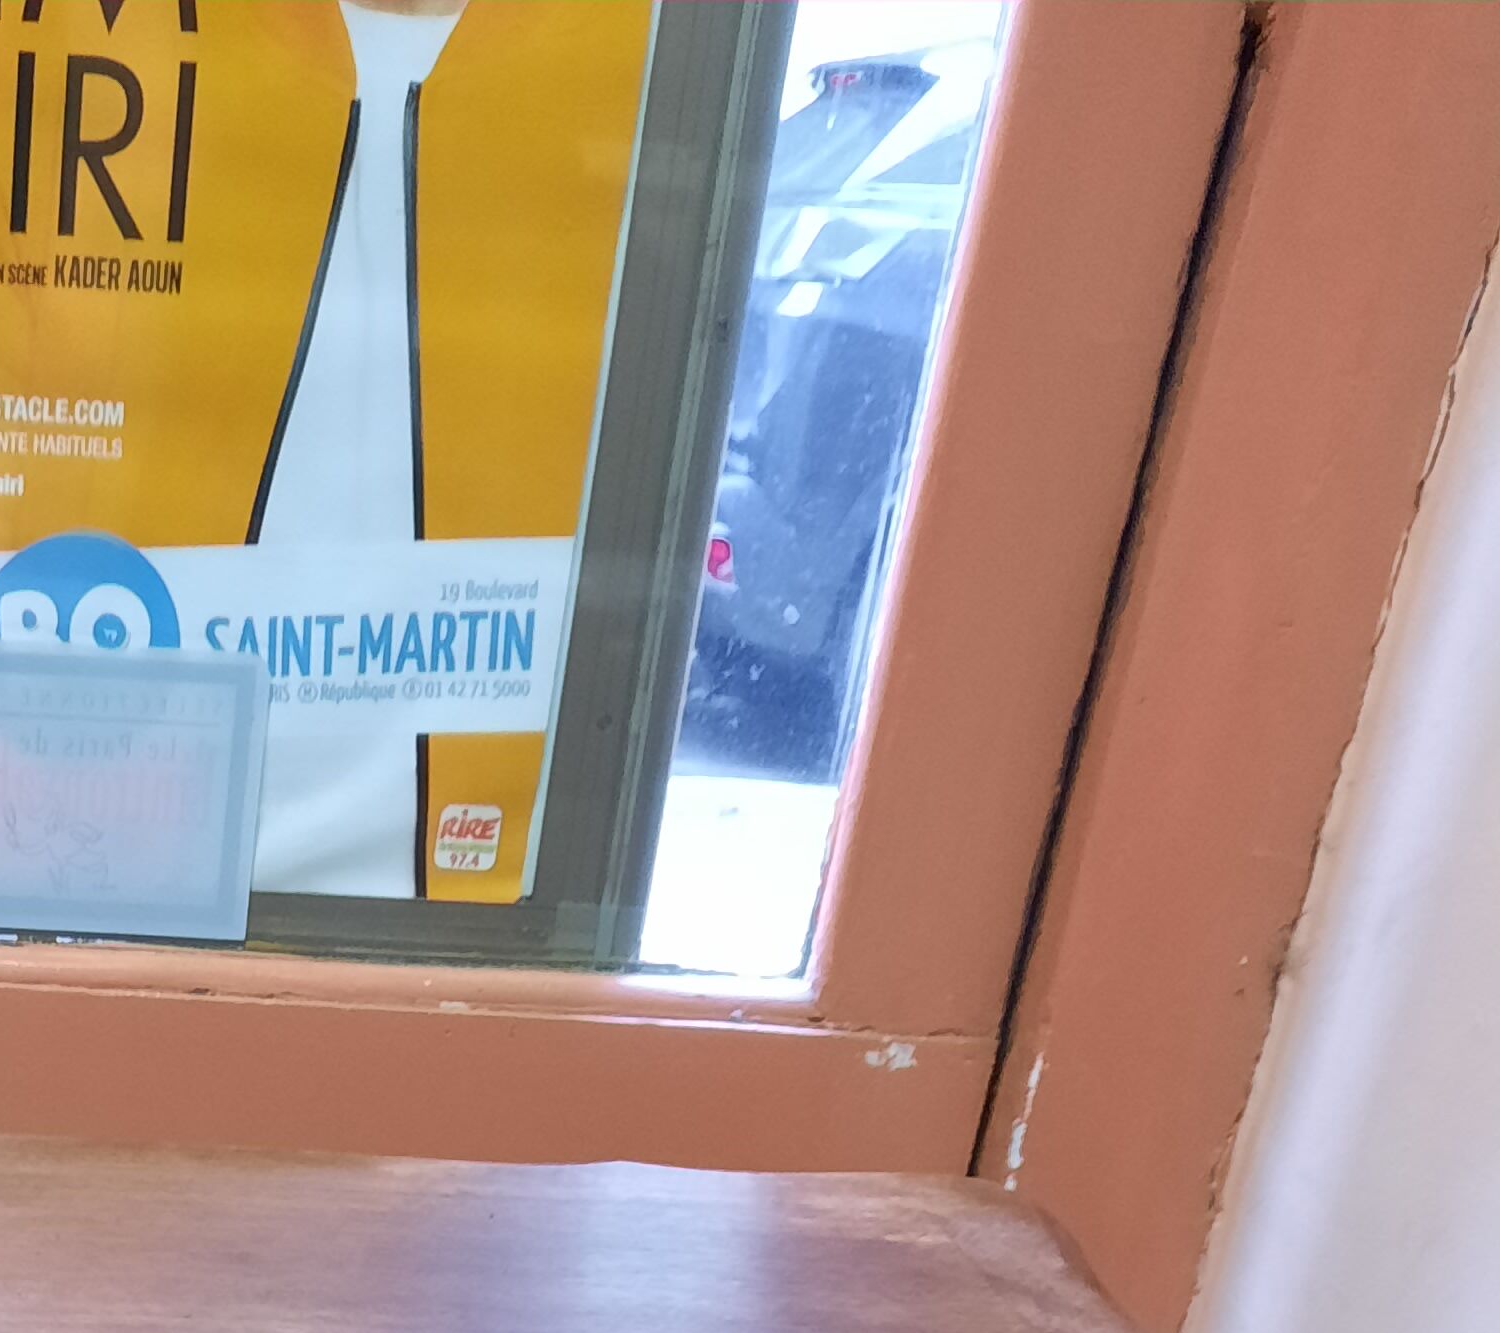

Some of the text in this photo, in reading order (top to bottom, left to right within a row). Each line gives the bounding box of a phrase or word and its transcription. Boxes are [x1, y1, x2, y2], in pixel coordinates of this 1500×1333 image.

[54, 255, 120, 291] KADER
[127, 259, 183, 294] AOUN
[33, 432, 124, 459] HABITUELS
[465, 579, 539, 601] Boulevard
[206, 608, 536, 678] SAINT-MARTIN
